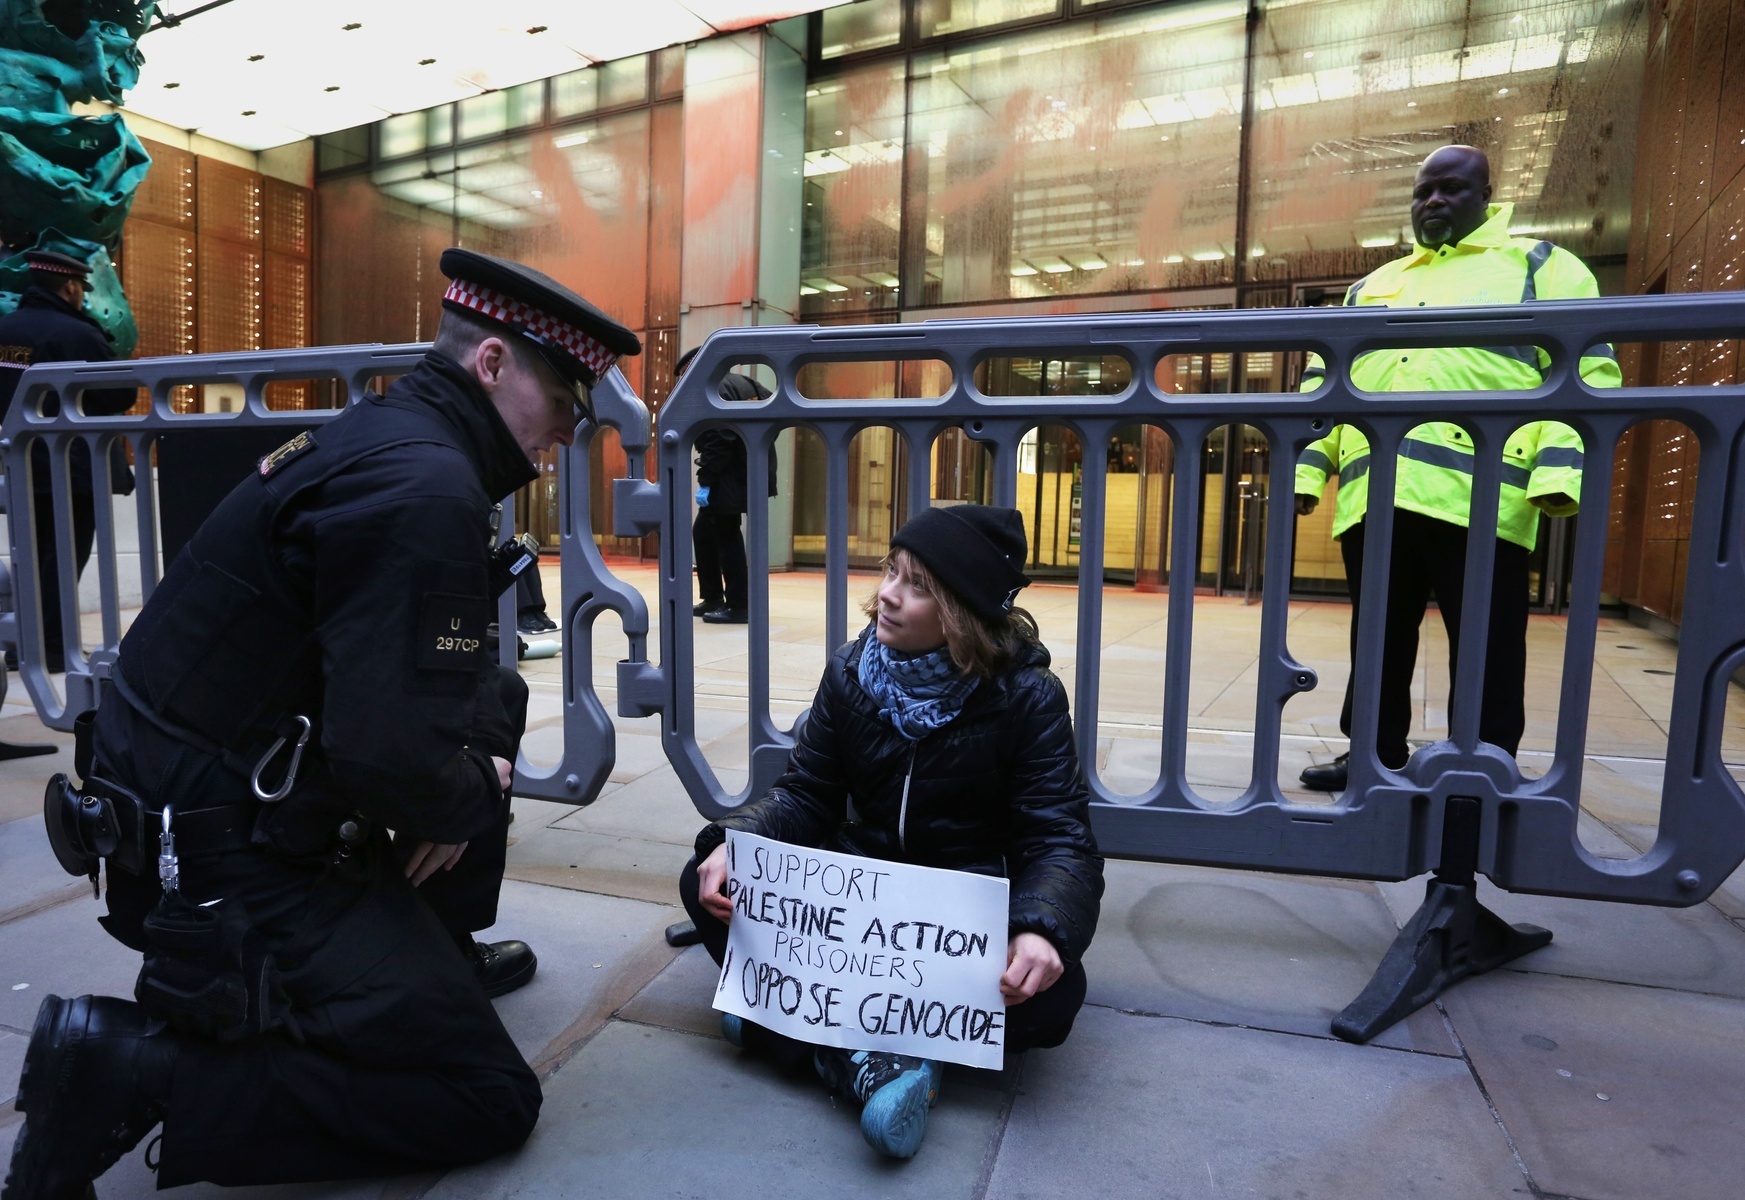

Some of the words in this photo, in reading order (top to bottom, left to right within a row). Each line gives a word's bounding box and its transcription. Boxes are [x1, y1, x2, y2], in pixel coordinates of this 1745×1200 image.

[436, 636, 480, 653] 297CP
[450, 618, 461, 631] U
[727, 837, 736, 872] I
[751, 847, 891, 902] SUPPORT
[726, 877, 847, 943] PALESTINE
[861, 917, 989, 958] ACTION
[774, 931, 926, 988] PRISONERS
[718, 946, 734, 993] I
[742, 957, 843, 1028] OPPOSE
[858, 992, 1005, 1046] GENOCIDE
